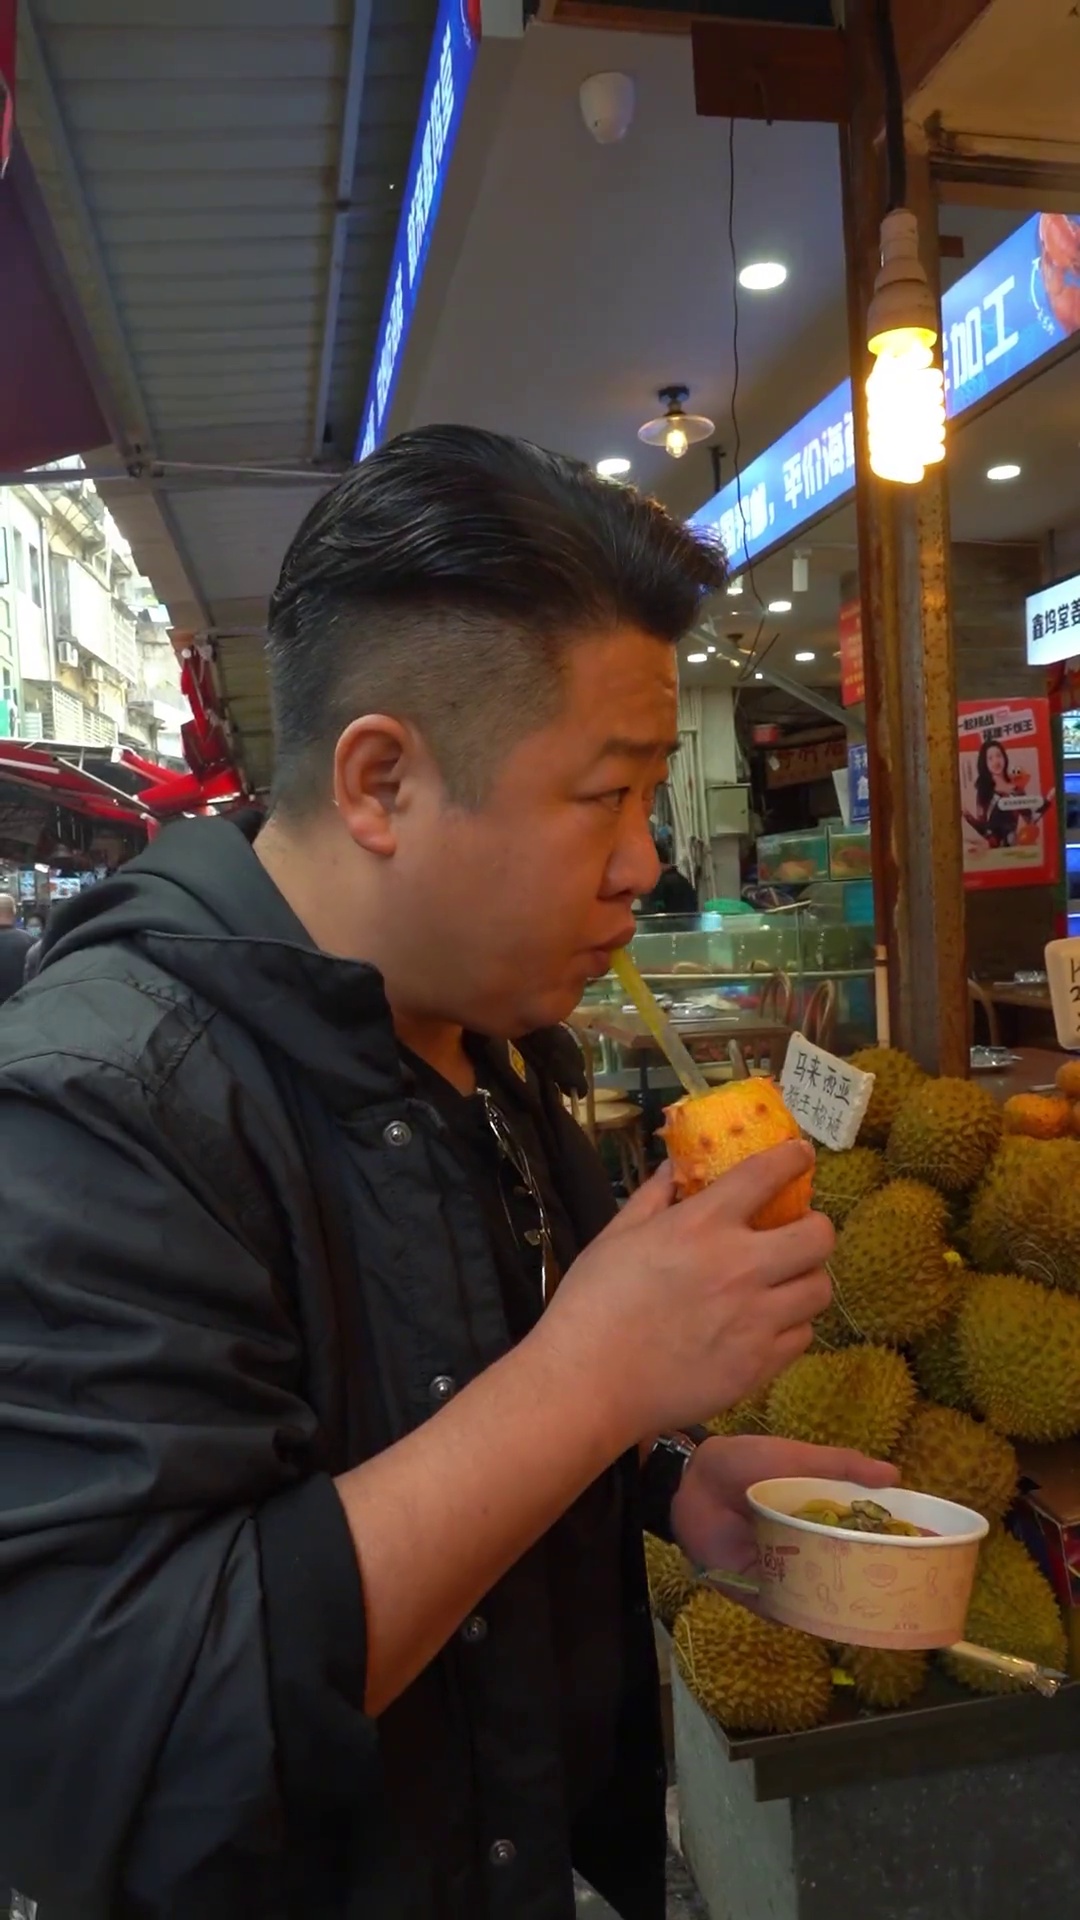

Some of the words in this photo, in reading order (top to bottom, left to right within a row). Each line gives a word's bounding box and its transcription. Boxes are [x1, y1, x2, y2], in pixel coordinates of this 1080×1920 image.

[943, 274, 1019, 391] 加工
[793, 1051, 852, 1107] 马来西亚
